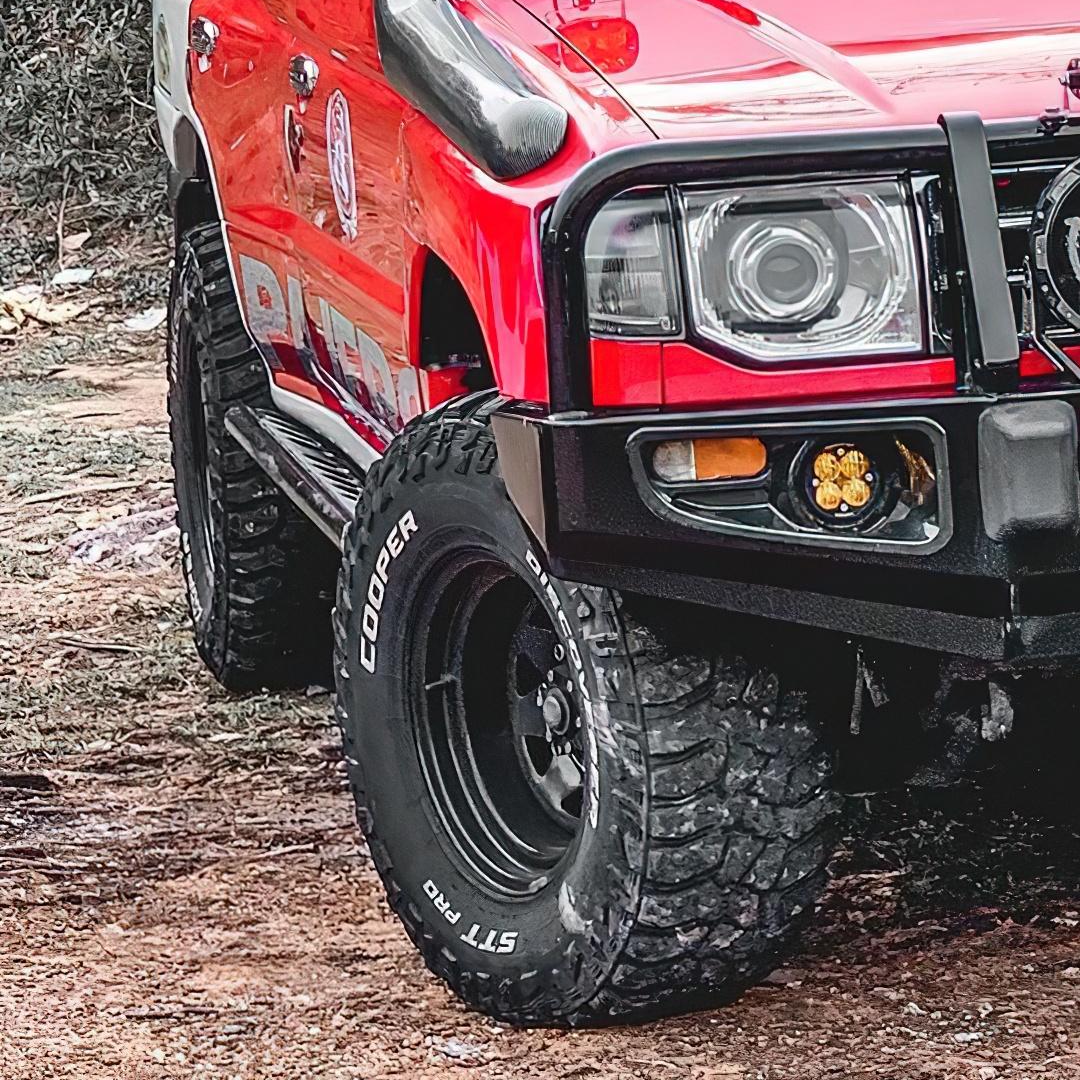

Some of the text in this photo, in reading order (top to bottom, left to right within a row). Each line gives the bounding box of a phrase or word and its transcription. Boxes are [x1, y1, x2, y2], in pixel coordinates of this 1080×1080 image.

[360, 509, 419, 674] COOPER
[422, 879, 519, 954] STT PRO
